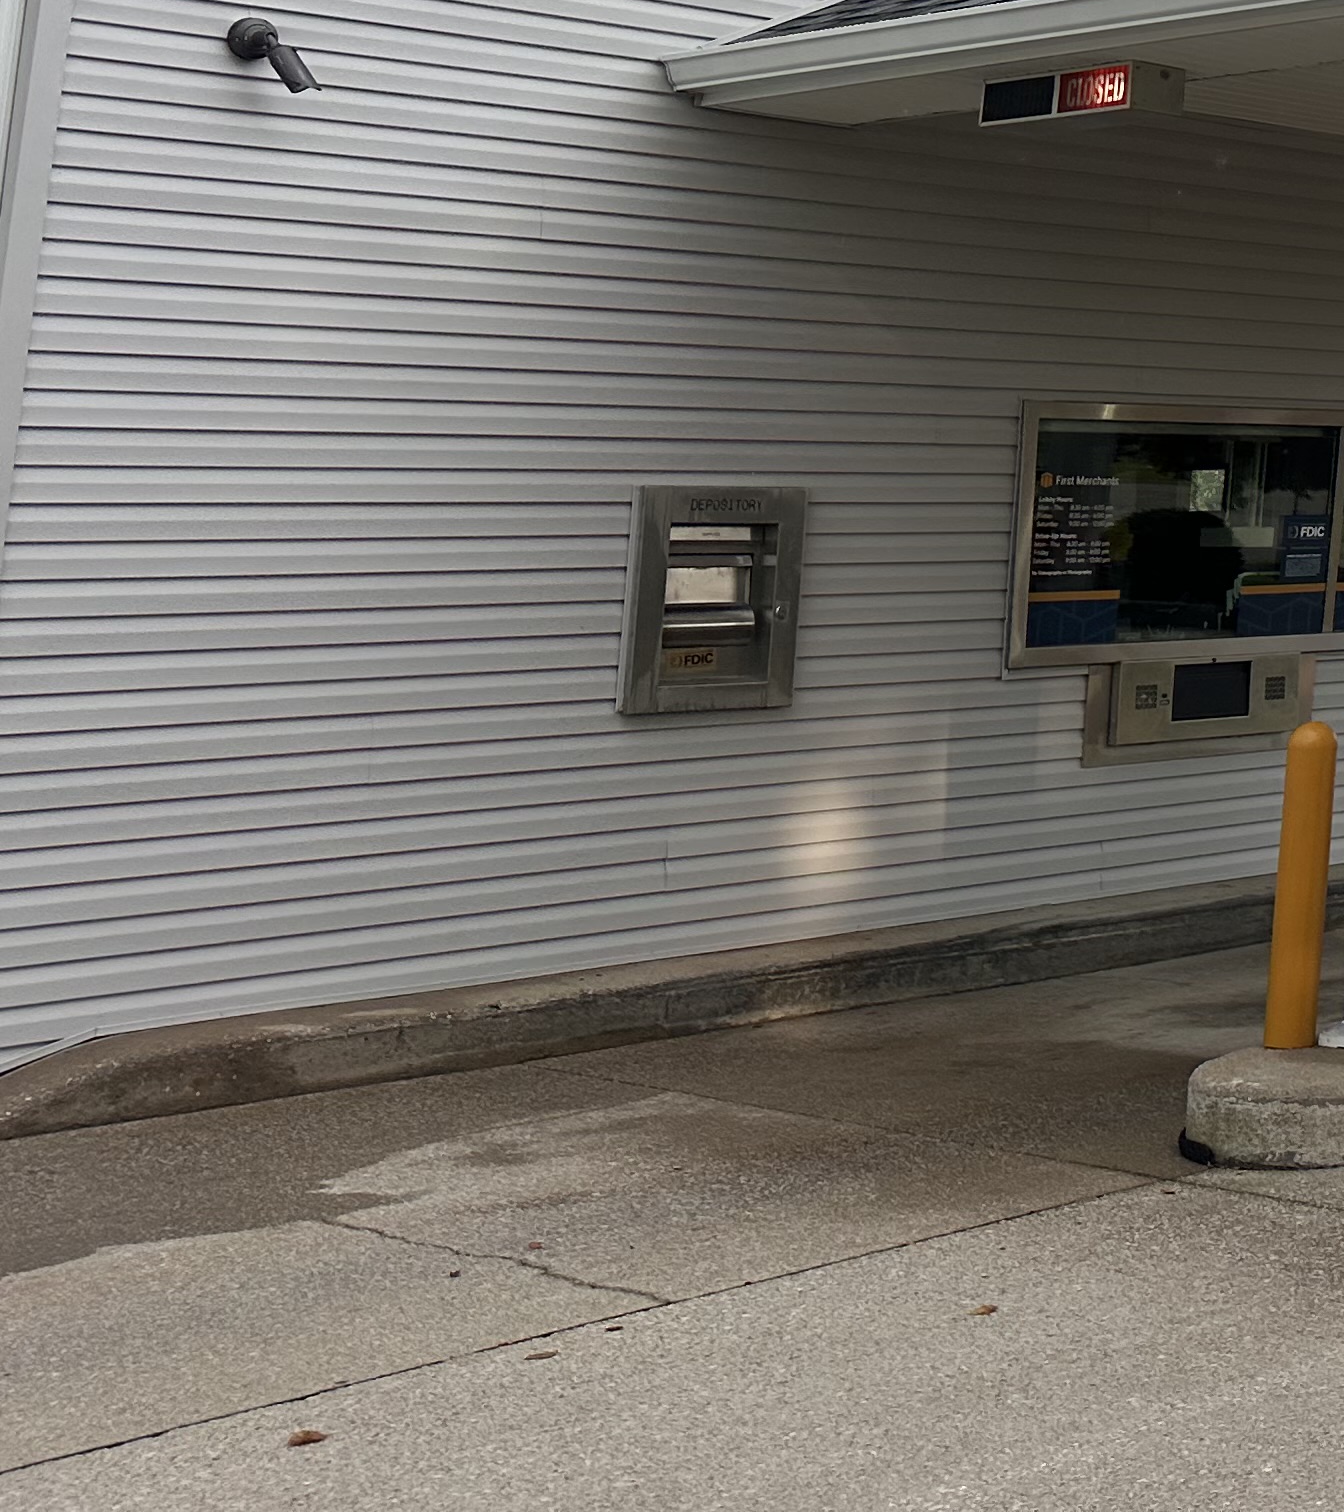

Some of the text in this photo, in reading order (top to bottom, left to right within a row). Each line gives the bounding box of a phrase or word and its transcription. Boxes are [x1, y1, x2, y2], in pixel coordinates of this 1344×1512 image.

[1066, 71, 1125, 107] CLOSED
[1055, 474, 1120, 486] First Merchants
[690, 498, 761, 512] DEPOSITORY
[1300, 525, 1325, 538] FDIC
[684, 652, 714, 666] FDIC
